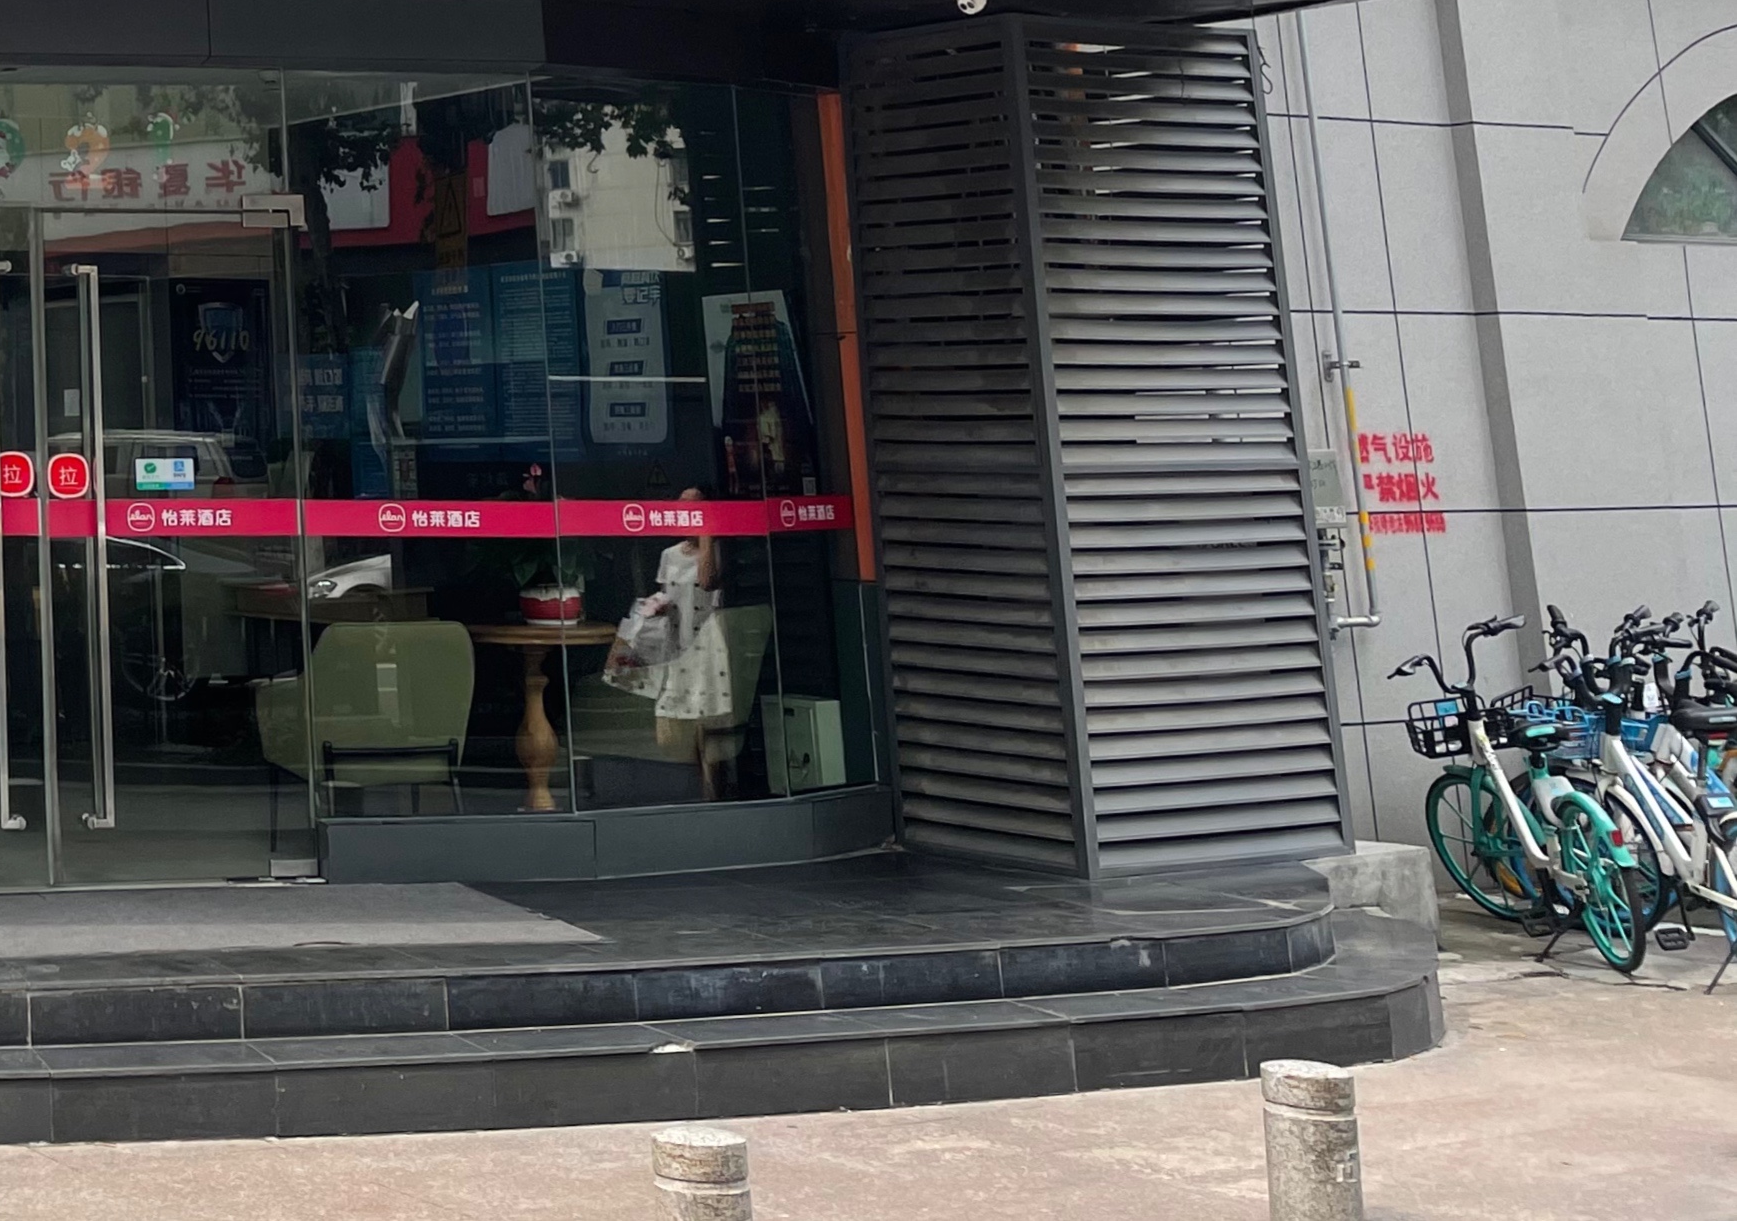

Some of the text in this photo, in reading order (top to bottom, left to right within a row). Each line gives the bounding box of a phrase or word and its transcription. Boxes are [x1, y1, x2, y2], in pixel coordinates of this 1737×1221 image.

[193, 329, 250, 352] 96110
[2, 464, 23, 485] 拉
[59, 465, 79, 486] 拉
[161, 509, 233, 527] 怡莱酒店
[412, 509, 481, 529] 怡莱酒店
[649, 508, 703, 528] 怡莱酒店
[798, 504, 835, 522] 怡莱酒店
